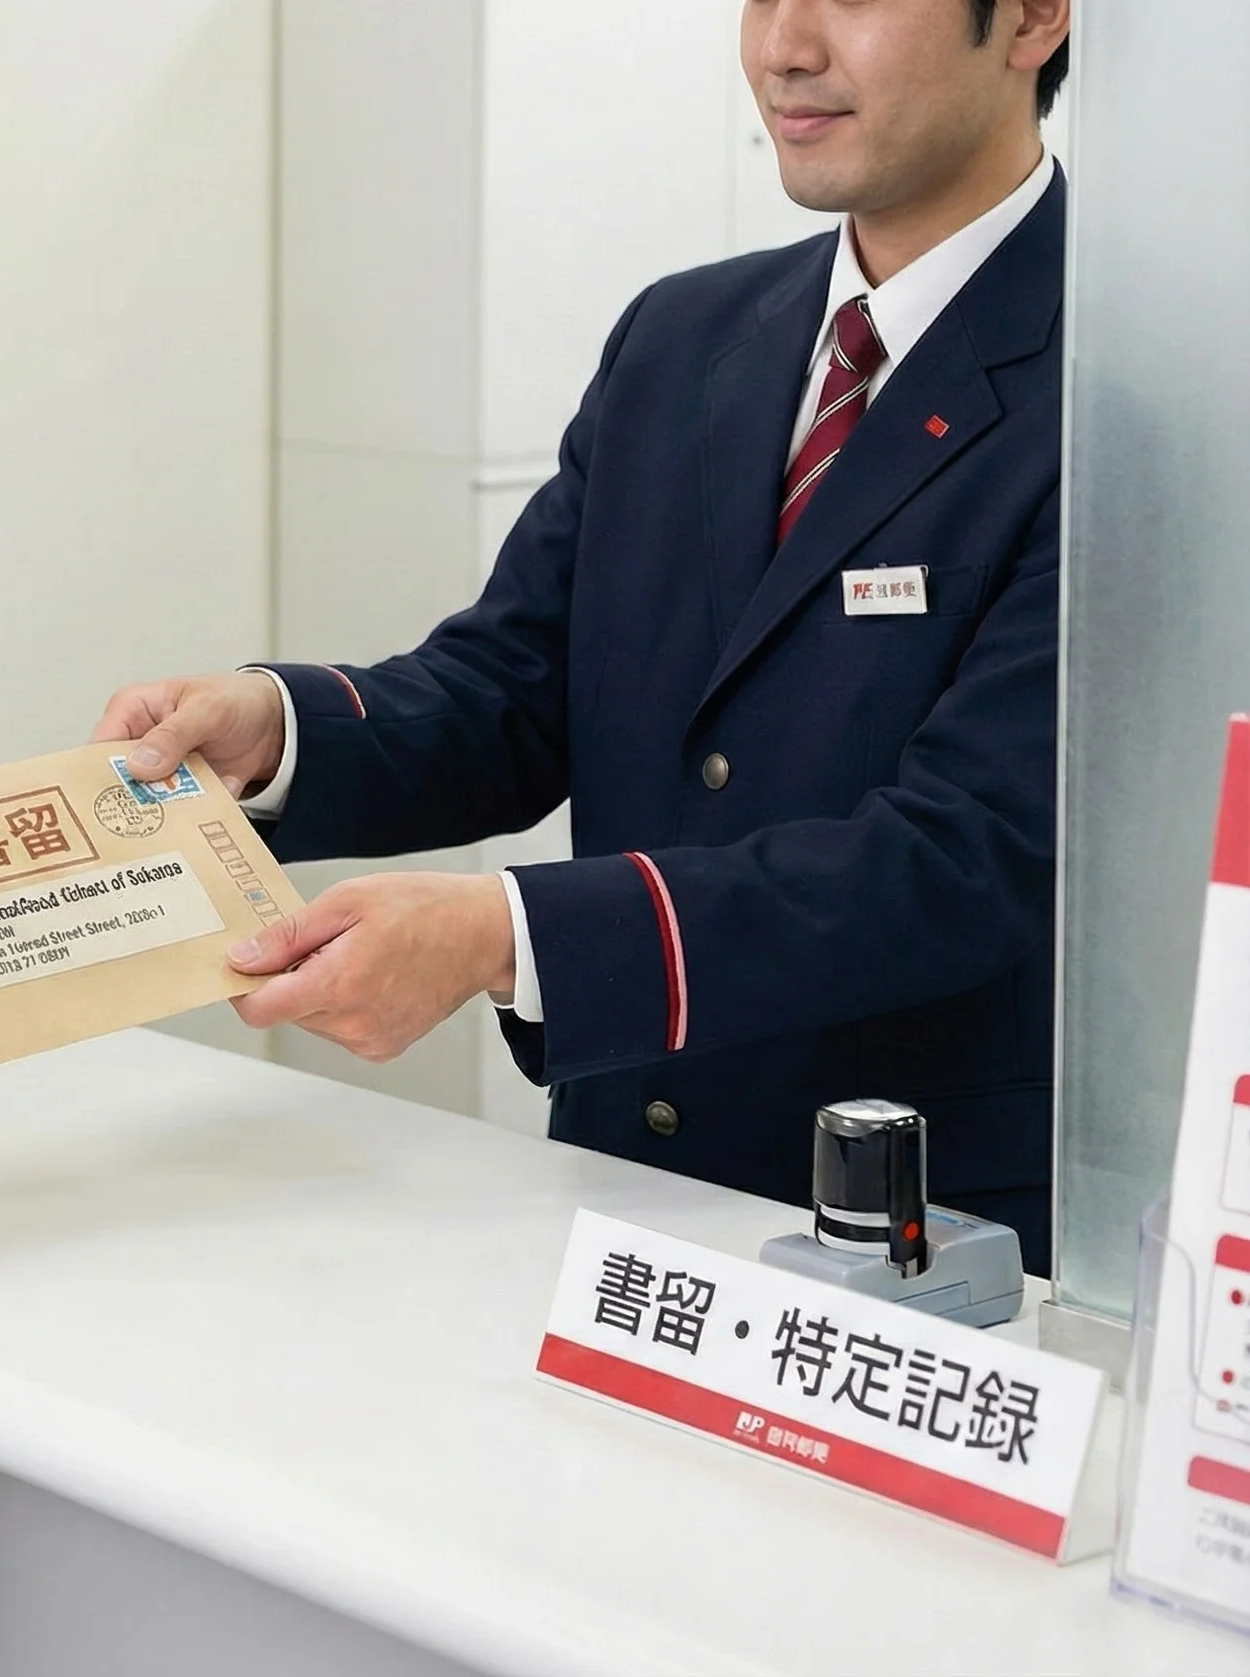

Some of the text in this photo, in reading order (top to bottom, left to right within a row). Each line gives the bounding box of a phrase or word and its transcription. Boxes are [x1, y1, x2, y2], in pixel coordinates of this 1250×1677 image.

[111, 872, 126, 890] of
[595, 1253, 1038, 1464] 書留・特定記録
